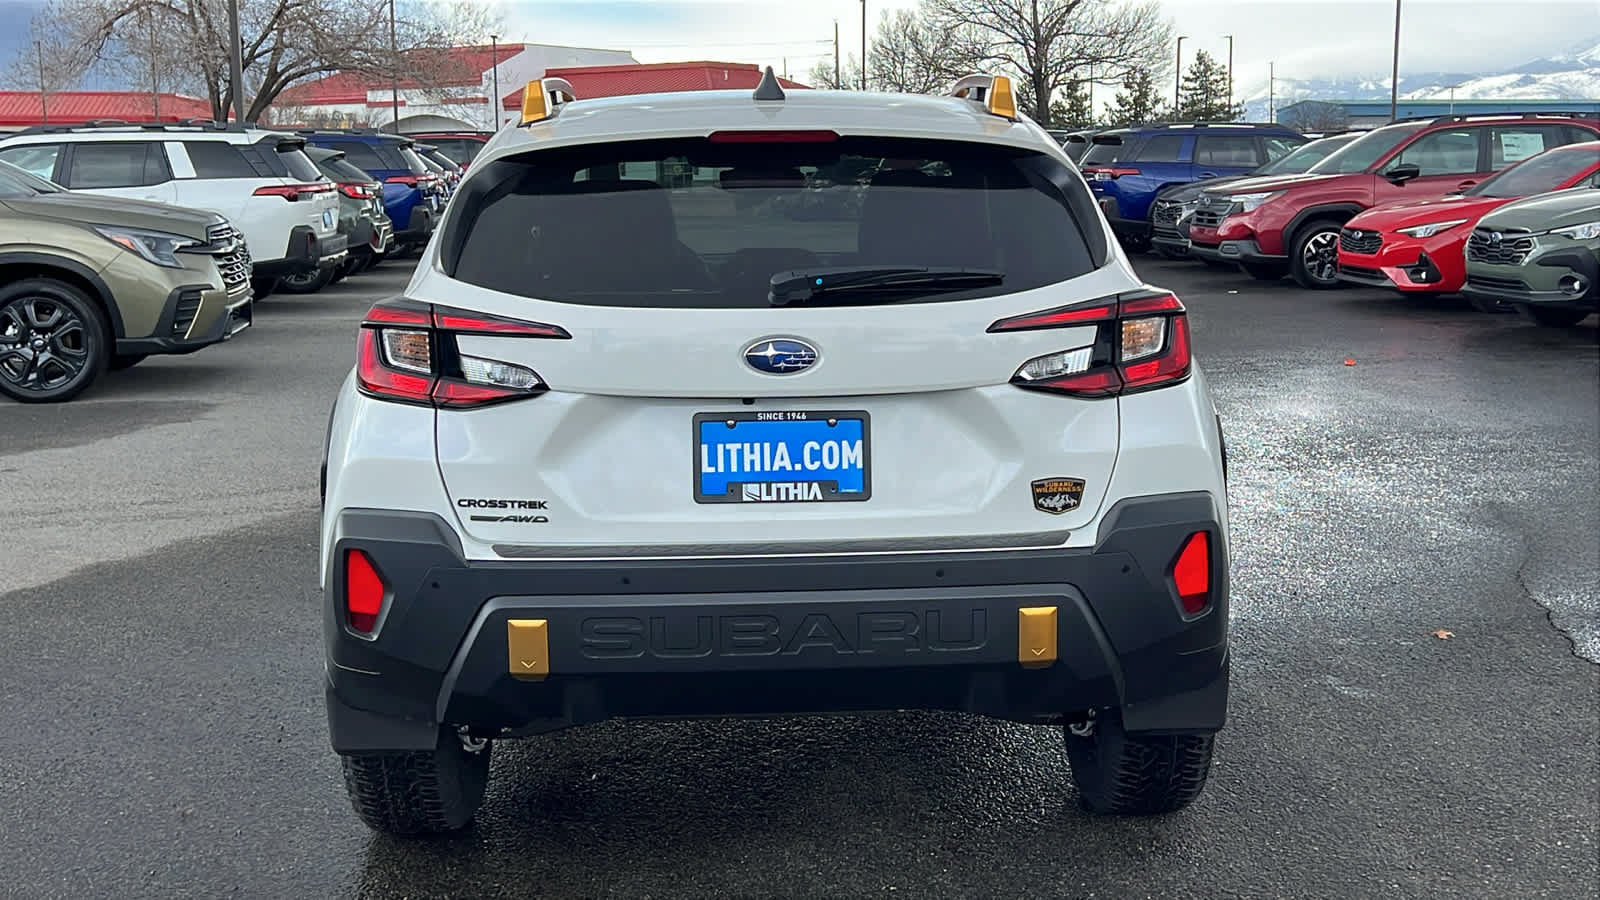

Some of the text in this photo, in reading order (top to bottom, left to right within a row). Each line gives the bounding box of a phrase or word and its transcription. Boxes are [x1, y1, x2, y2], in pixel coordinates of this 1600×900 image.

[757, 412, 807, 421] SINCE 1946
[701, 440, 863, 473] LITHIA.COM
[760, 482, 823, 501] LITHIA
[457, 499, 548, 510] CROSSTREK
[500, 515, 549, 523] AWD
[580, 608, 988, 659] SUBARU
